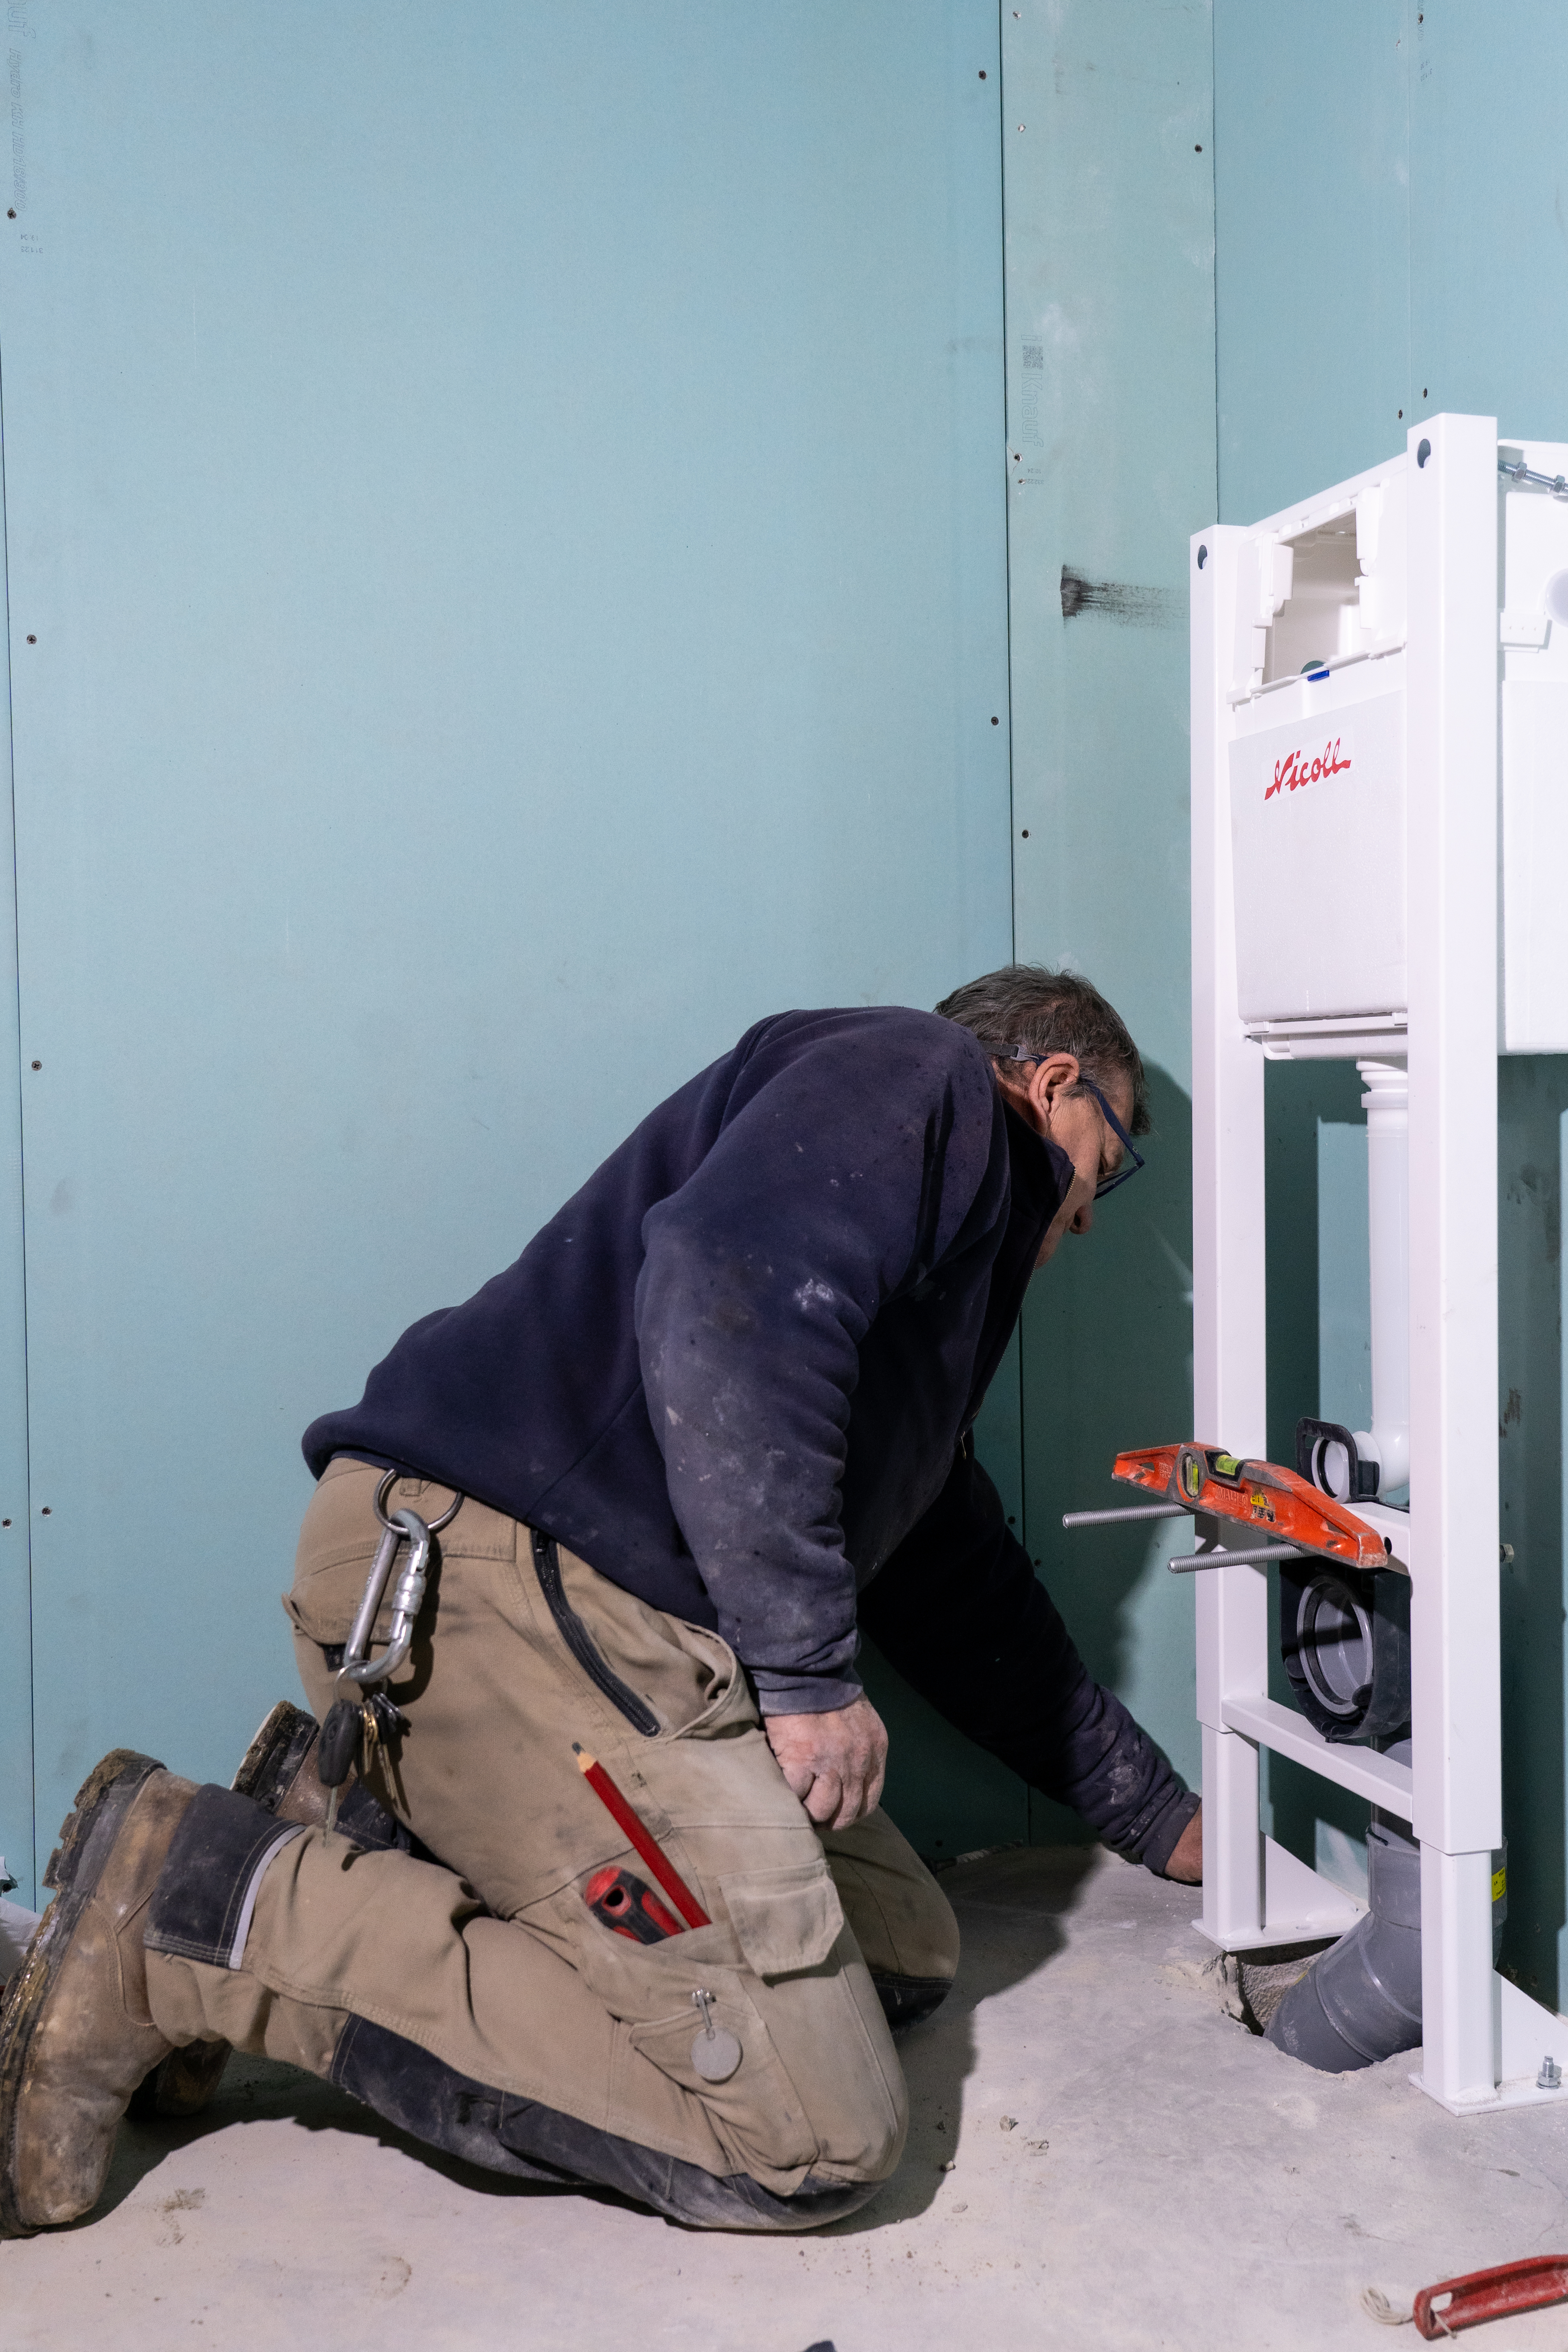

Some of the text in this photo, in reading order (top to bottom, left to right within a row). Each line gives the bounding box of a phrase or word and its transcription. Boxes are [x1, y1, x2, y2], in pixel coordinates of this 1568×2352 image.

[7, 47, 23, 99] Hydro
[11, 102, 24, 130] KH
[1021, 373, 1044, 448] Knauf
[1264, 737, 1351, 800] Nicoll
